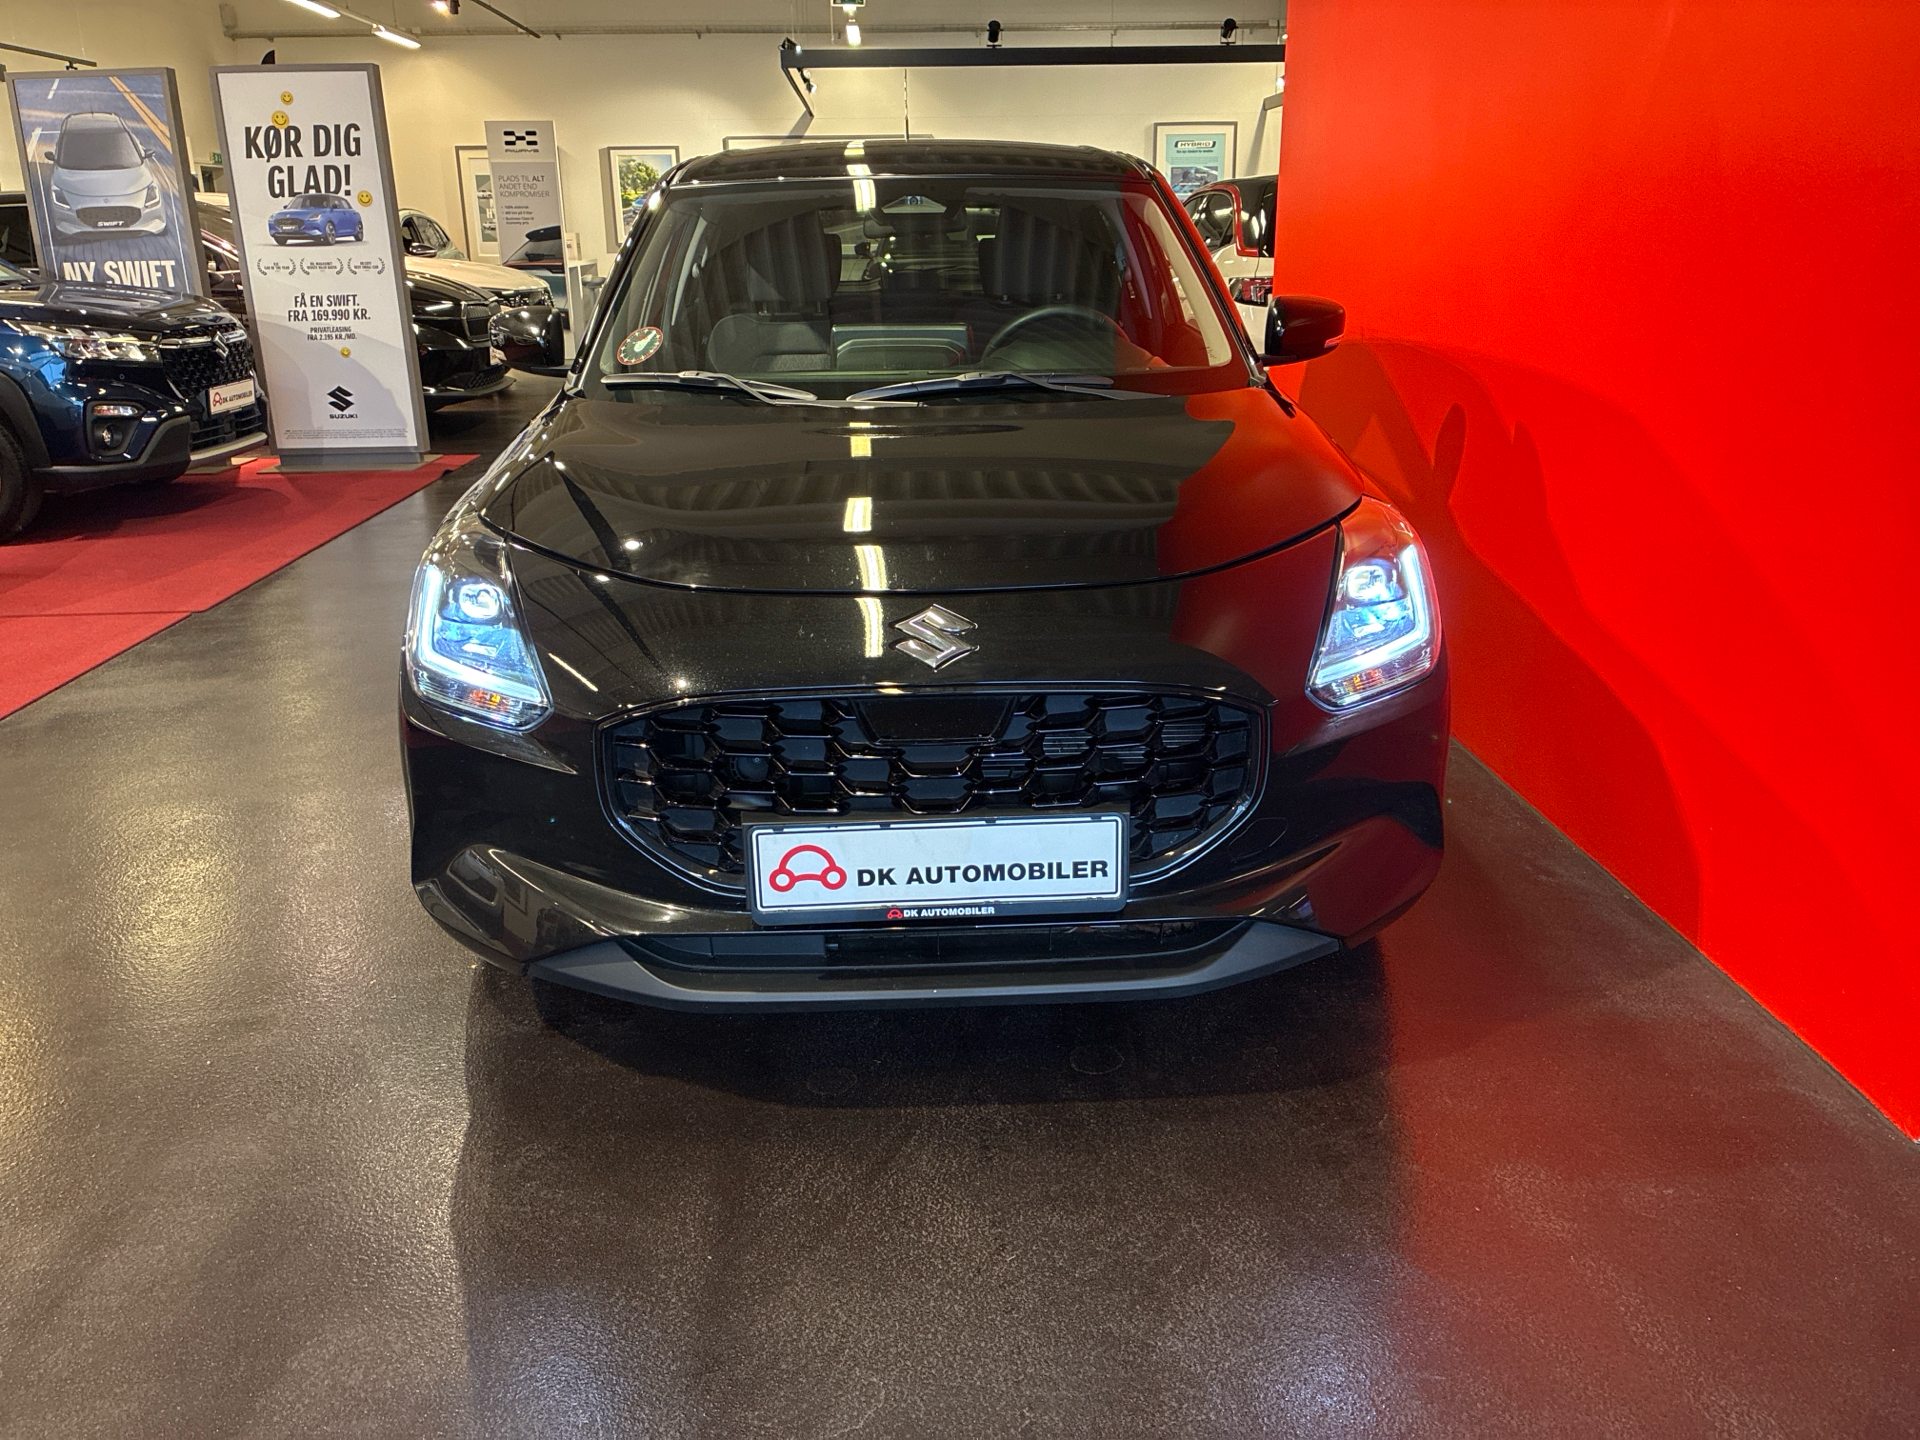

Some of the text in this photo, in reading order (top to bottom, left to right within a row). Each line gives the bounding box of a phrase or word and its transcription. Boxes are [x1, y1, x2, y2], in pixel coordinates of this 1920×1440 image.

[245, 123, 361, 162] KØR DIG
[268, 164, 352, 198] GLAD!
[62, 259, 176, 288] NY SWIFT
[294, 292, 360, 308] FÅ EN SWIFT.
[287, 308, 371, 322] FRA 169.990 KR.
[856, 860, 1109, 887] DK AUTOMOBILER
[903, 906, 995, 917] DK AUTOMOBILER
